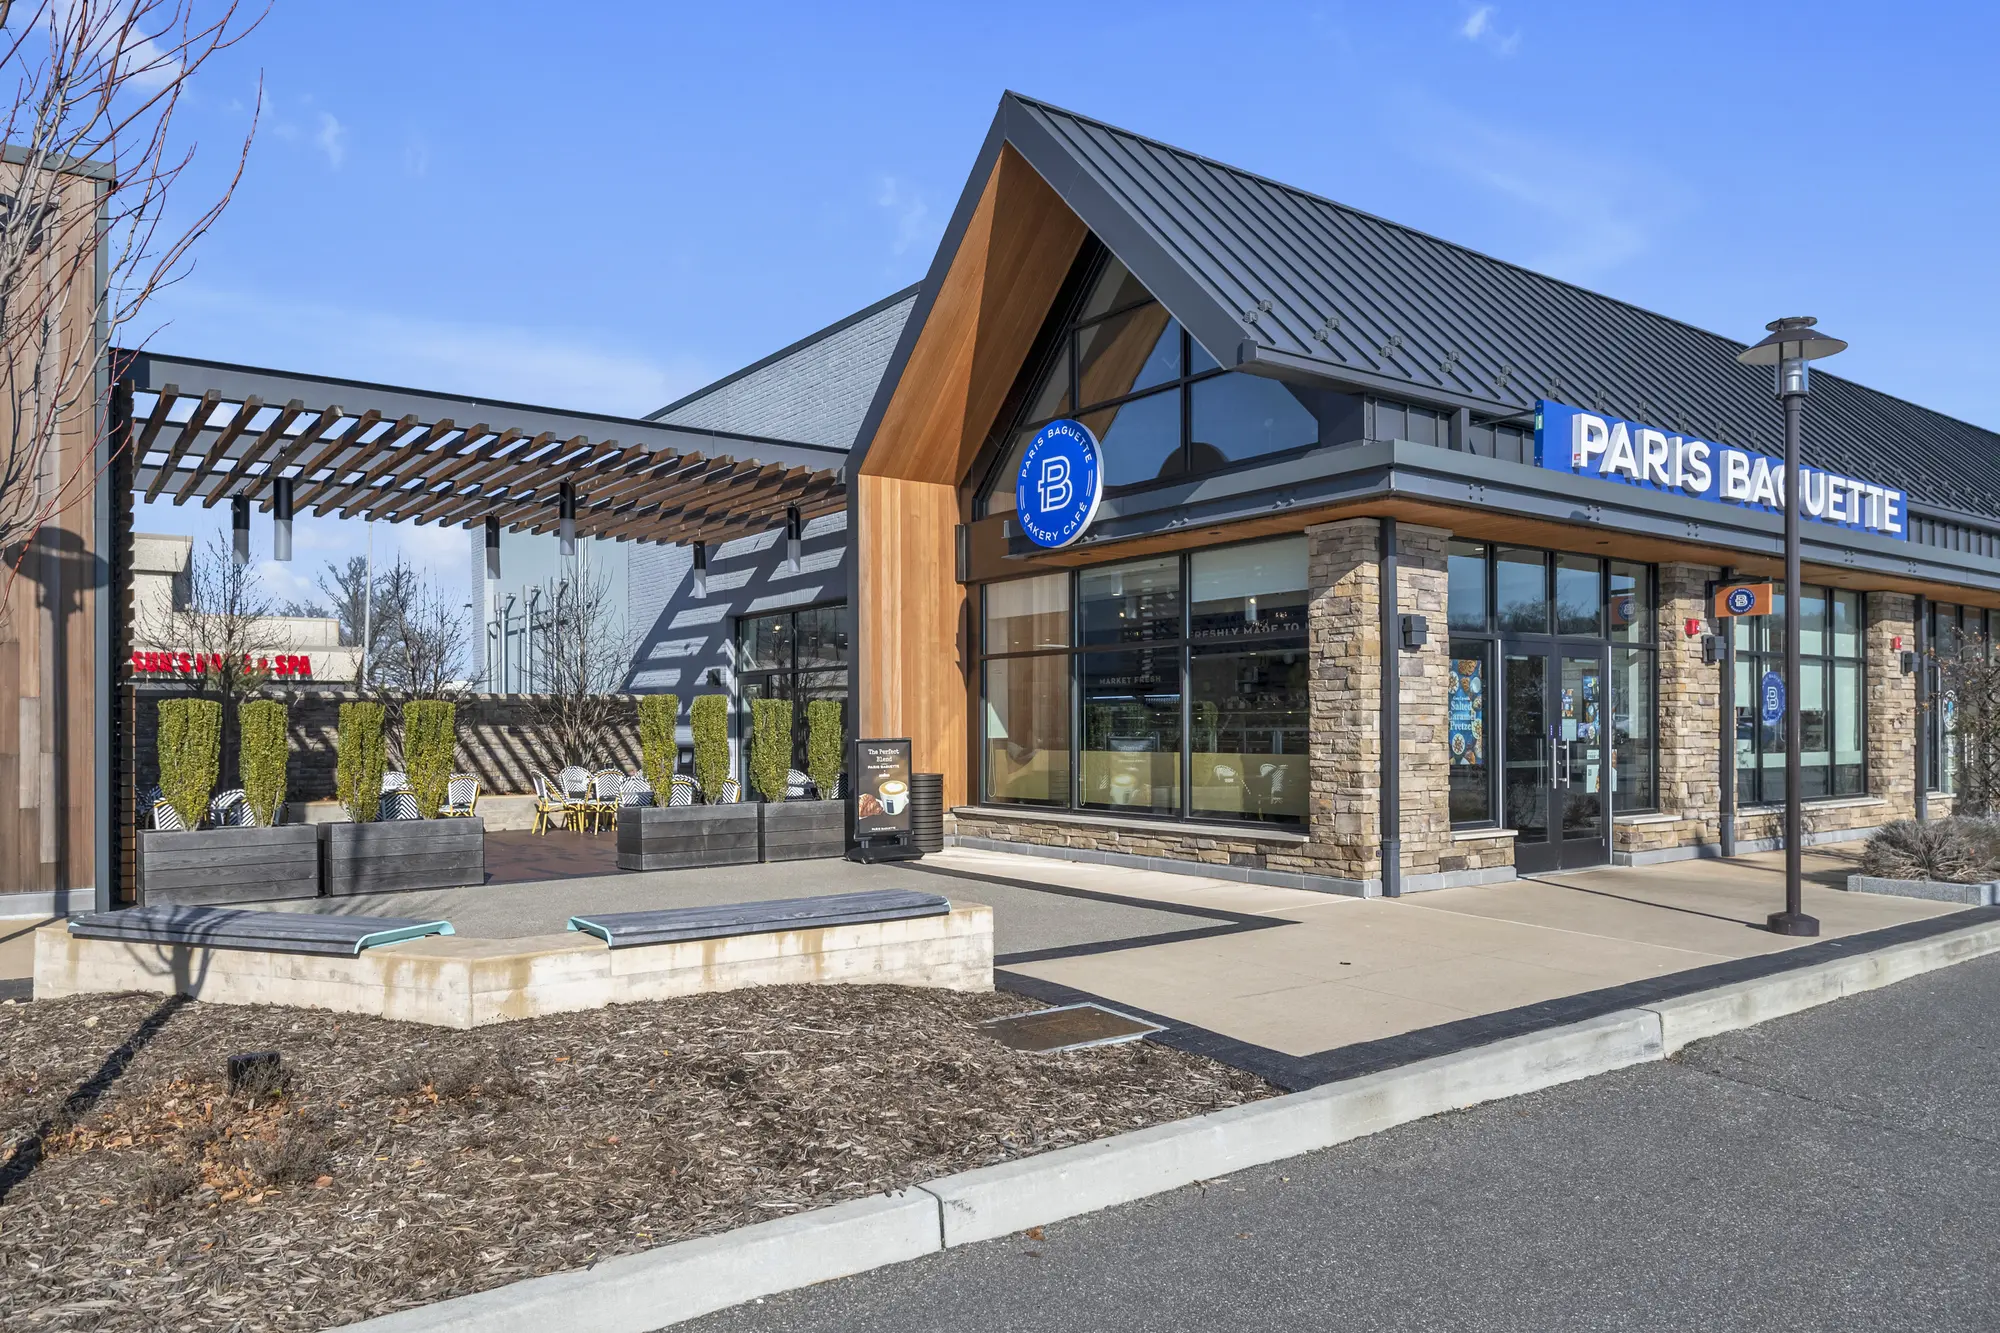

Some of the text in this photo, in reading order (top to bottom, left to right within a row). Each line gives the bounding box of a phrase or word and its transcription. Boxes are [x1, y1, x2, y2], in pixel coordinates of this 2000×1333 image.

[1021, 425, 1093, 478] PARIS BAGUETTE
[1572, 413, 1711, 492] PARIS
[1023, 501, 1087, 541] BAKERY CAFÉ
[1244, 624, 1278, 635] MADE
[1283, 622, 1299, 631] TO
[131, 651, 191, 673] SUN'S
[275, 655, 312, 675] SPA
[1099, 675, 1161, 685] MARKET FRESH
[1451, 701, 1472, 711] Salted
